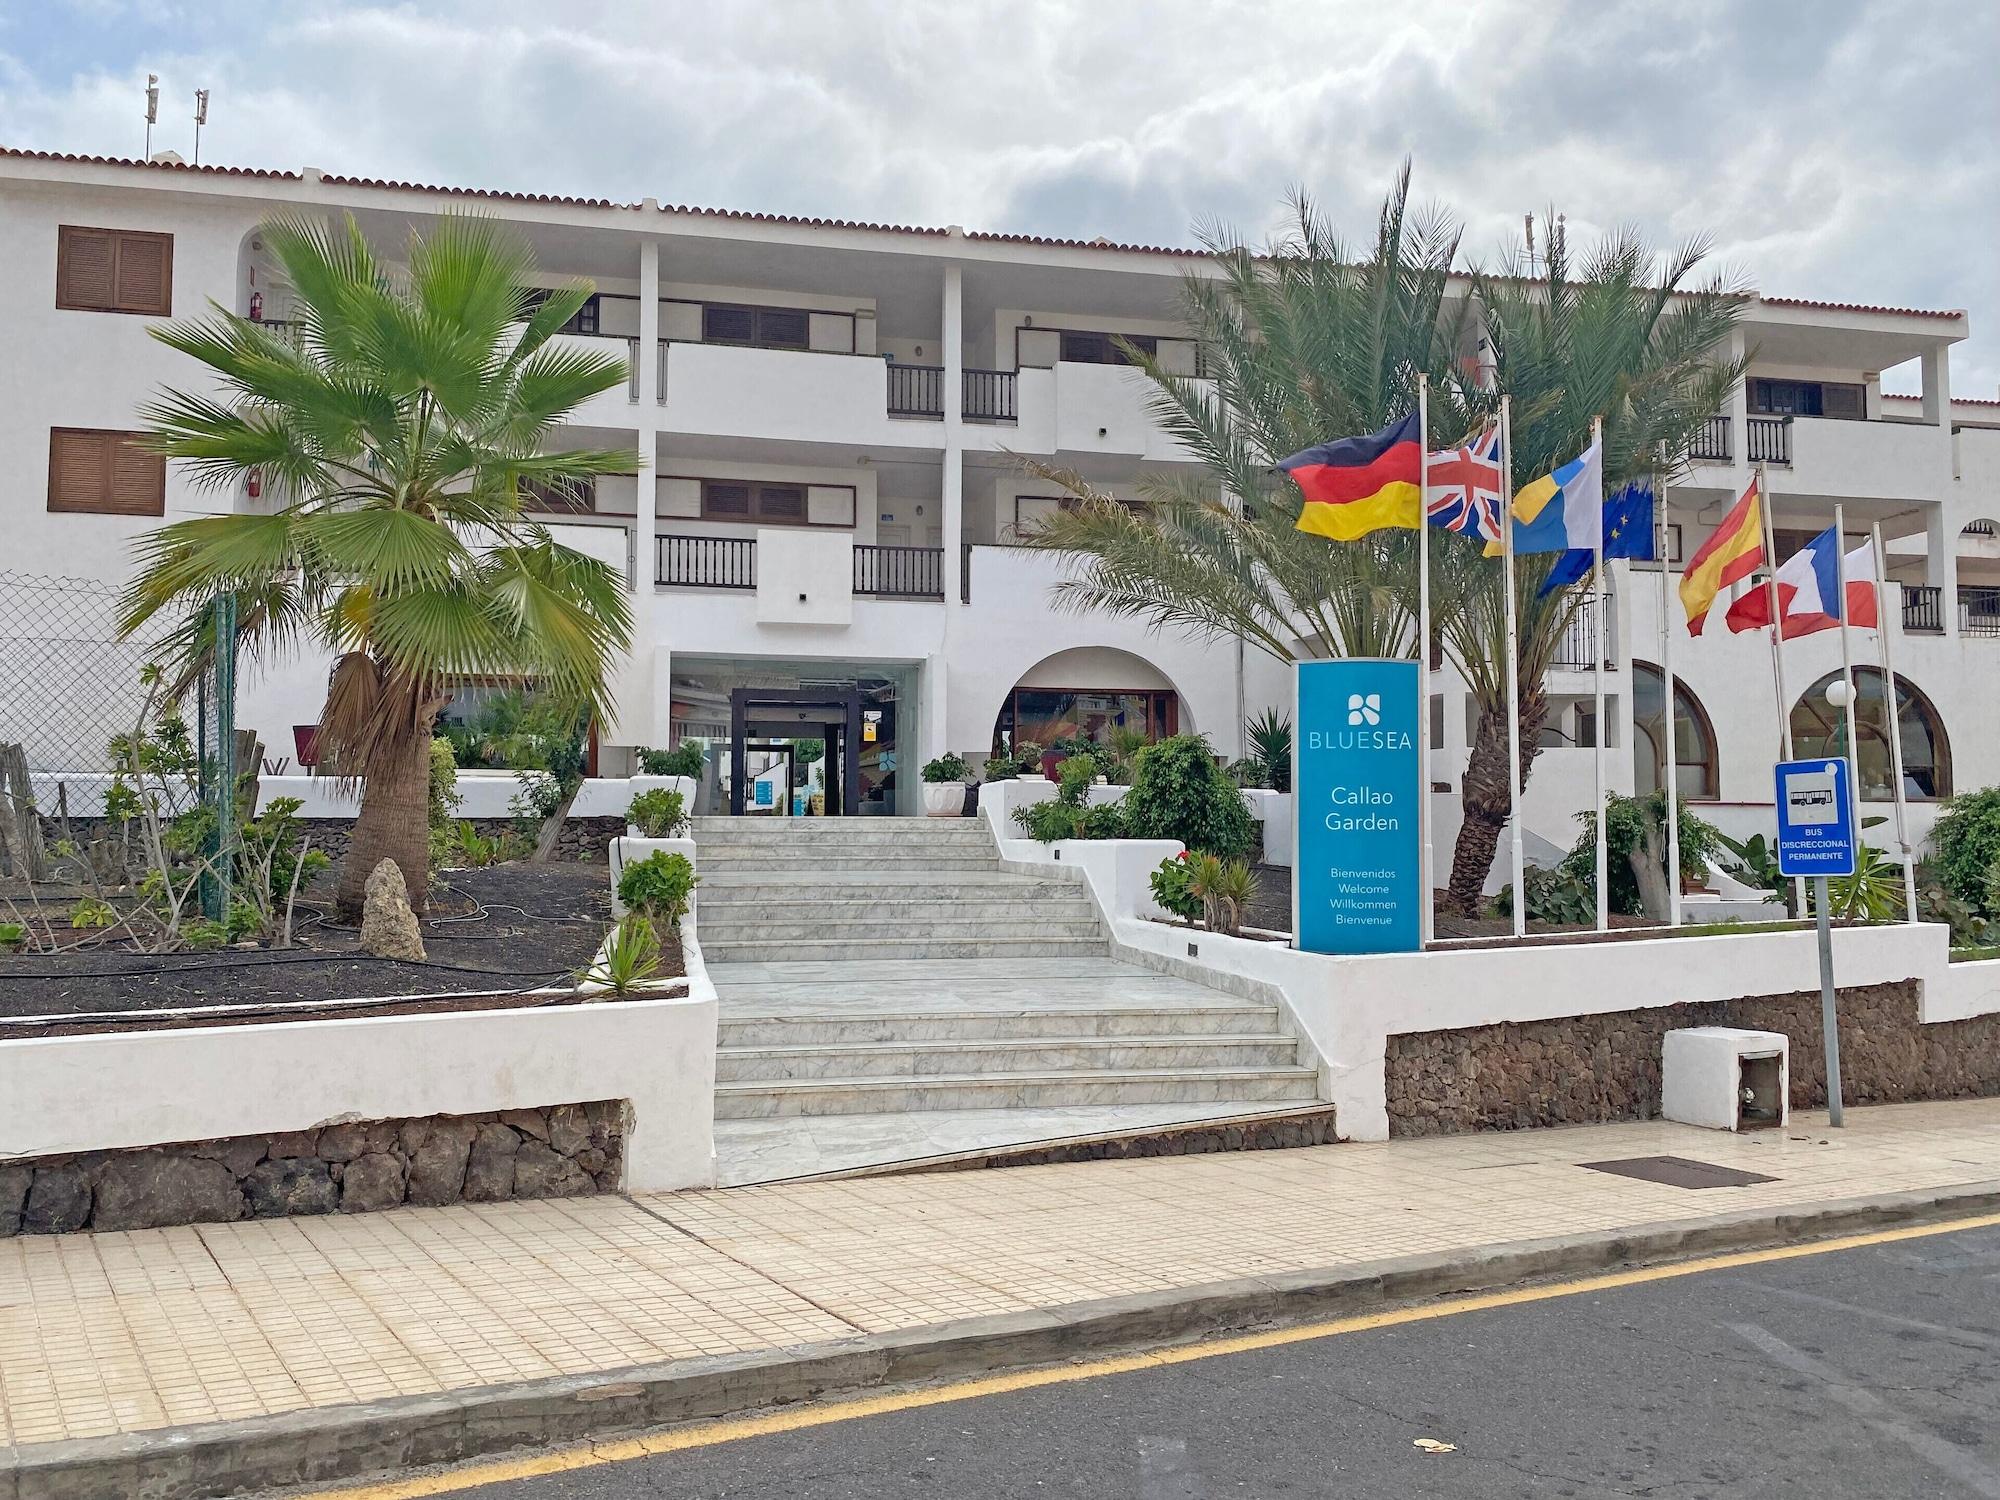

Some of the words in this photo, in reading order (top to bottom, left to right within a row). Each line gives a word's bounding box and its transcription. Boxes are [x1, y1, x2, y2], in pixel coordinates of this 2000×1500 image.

[1309, 732, 1411, 749] BLUESEA
[1331, 787, 1393, 804] Callao
[1325, 812, 1398, 831] Garden
[1805, 828, 1823, 836] BUS
[1782, 840, 1849, 849] DISCRECCIONAL
[1789, 852, 1843, 860] PERMANENTE
[1330, 868, 1396, 879] Bienvenidos
[1338, 883, 1389, 894] Welcome
[1330, 898, 1397, 910] Willkommen
[1336, 914, 1392, 925] Bienvenue
